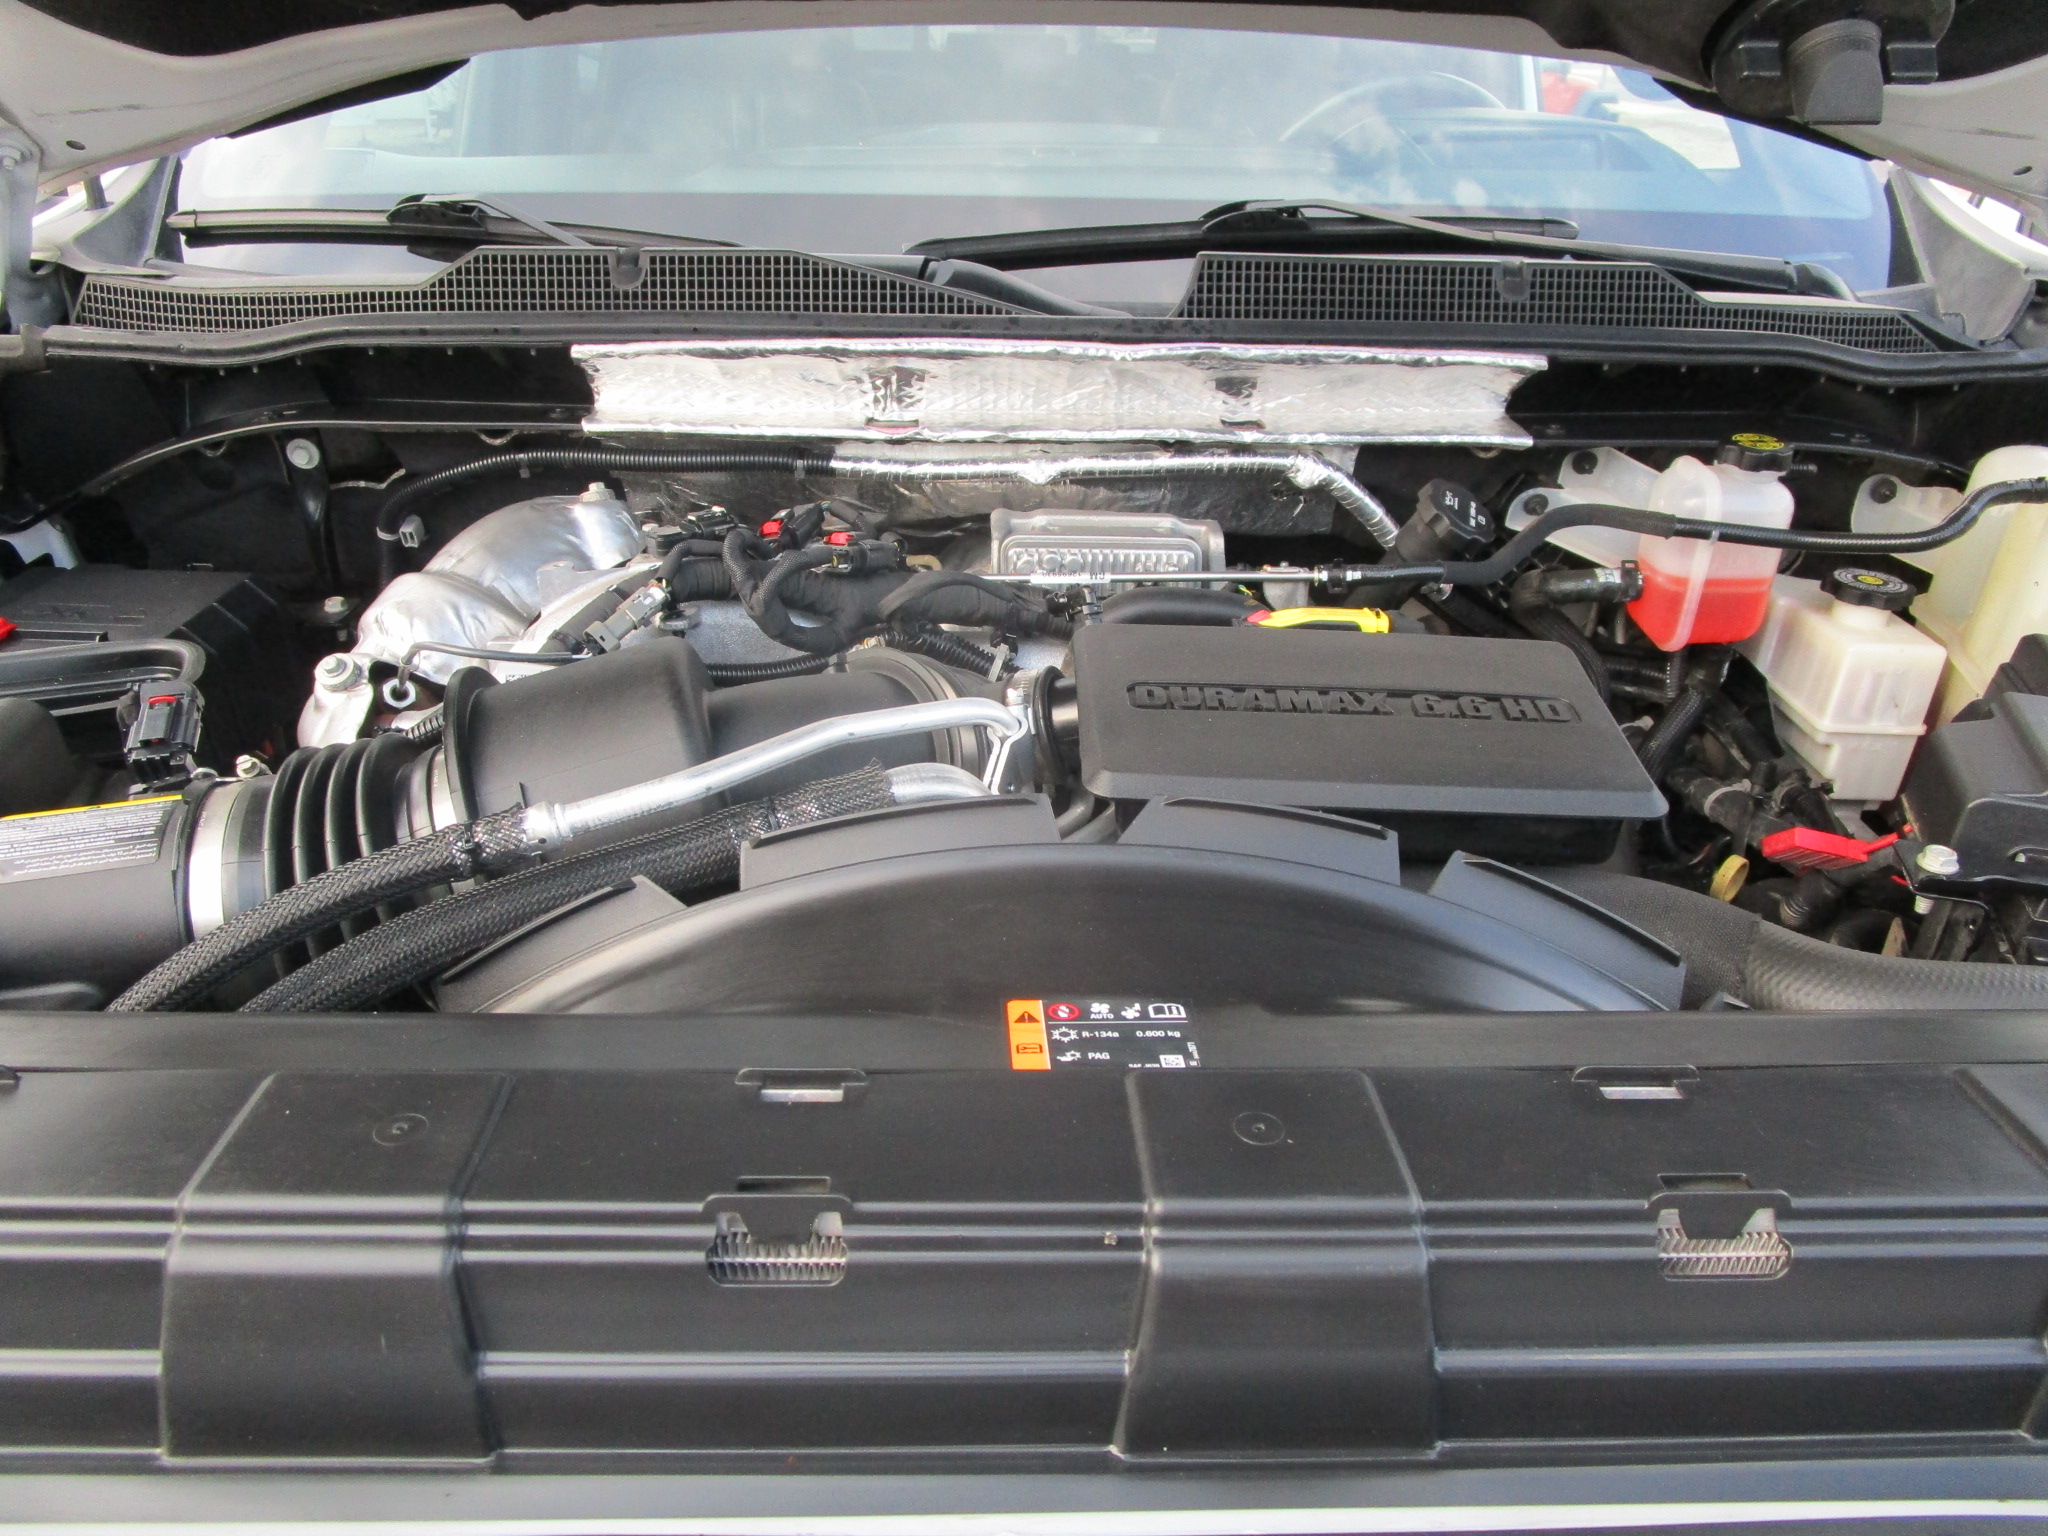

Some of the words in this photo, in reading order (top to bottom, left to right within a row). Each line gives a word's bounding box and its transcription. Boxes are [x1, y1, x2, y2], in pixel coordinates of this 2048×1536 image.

[1132, 684, 1395, 716] DURAMAX
[1411, 693, 1493, 720] 6.6
[1500, 696, 1576, 723] HD
[1081, 1030, 1120, 1038] R-134a
[1167, 1030, 1181, 1038] kg
[1087, 1052, 1111, 1060] PAG
